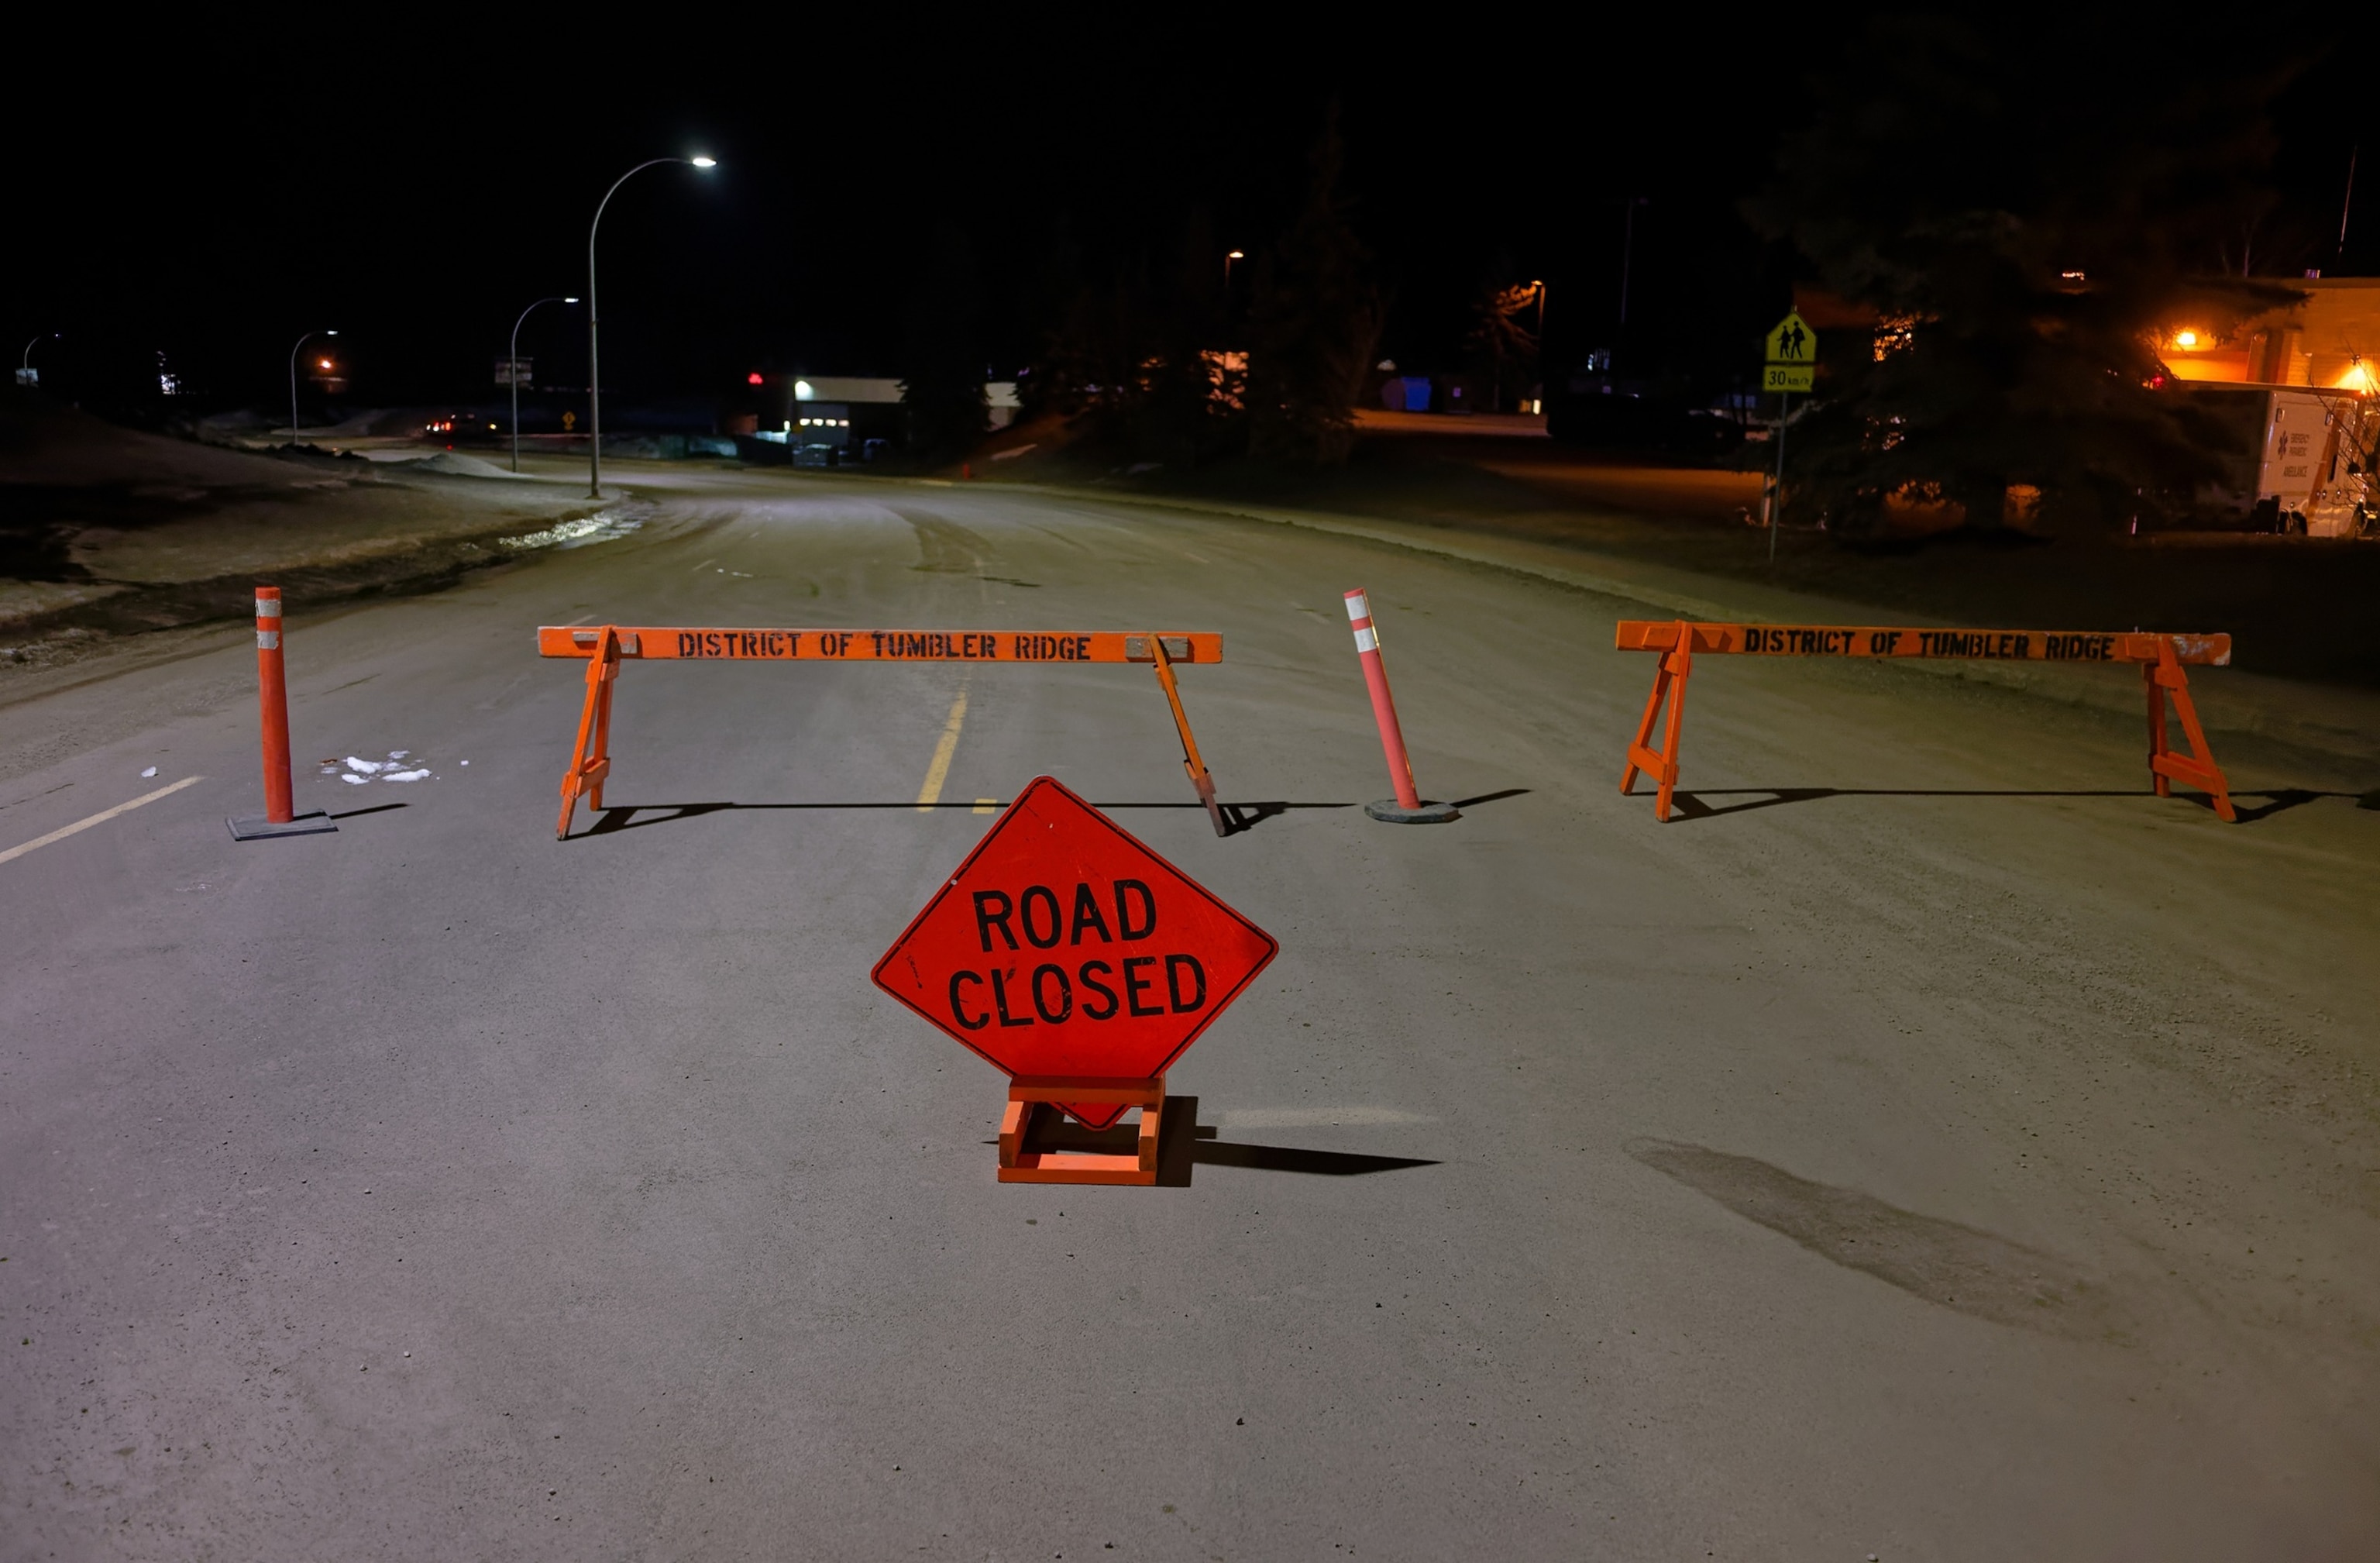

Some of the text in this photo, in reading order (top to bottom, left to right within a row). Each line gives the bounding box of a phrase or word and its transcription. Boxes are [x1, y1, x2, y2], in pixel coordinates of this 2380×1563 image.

[1768, 370, 1787, 386] 30
[678, 632, 1092, 660] DISTRICT OF TUMBLER RIDGE
[1745, 628, 2115, 660] DISTRICT OF TUMBLER RIDGE
[972, 878, 1157, 953] ROAD
[948, 953, 1207, 1031] CLOSED
